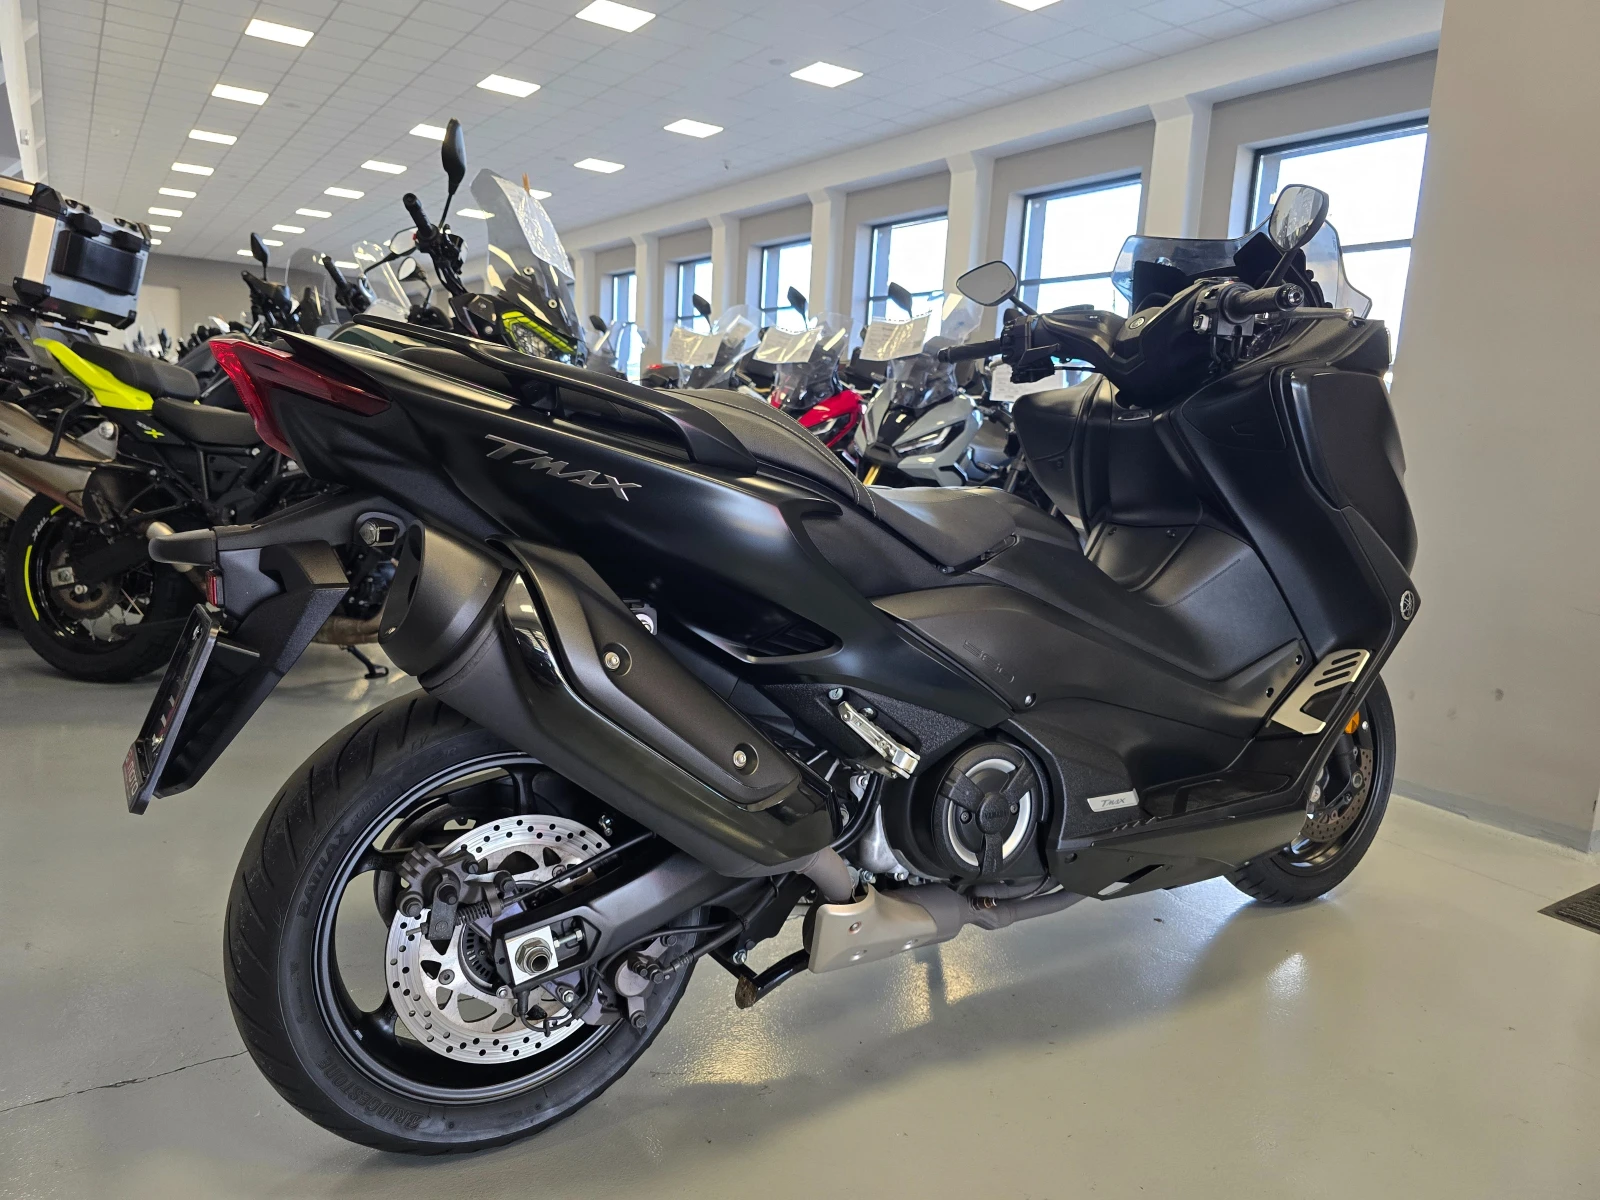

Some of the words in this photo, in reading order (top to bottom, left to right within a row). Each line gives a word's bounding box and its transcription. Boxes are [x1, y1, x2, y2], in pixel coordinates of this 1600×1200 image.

[484, 433, 642, 502] TMAX
[1100, 798, 1126, 808] TMAX
[298, 824, 351, 919] BATTLAX
[316, 1053, 426, 1131] BRIDGESTONE
